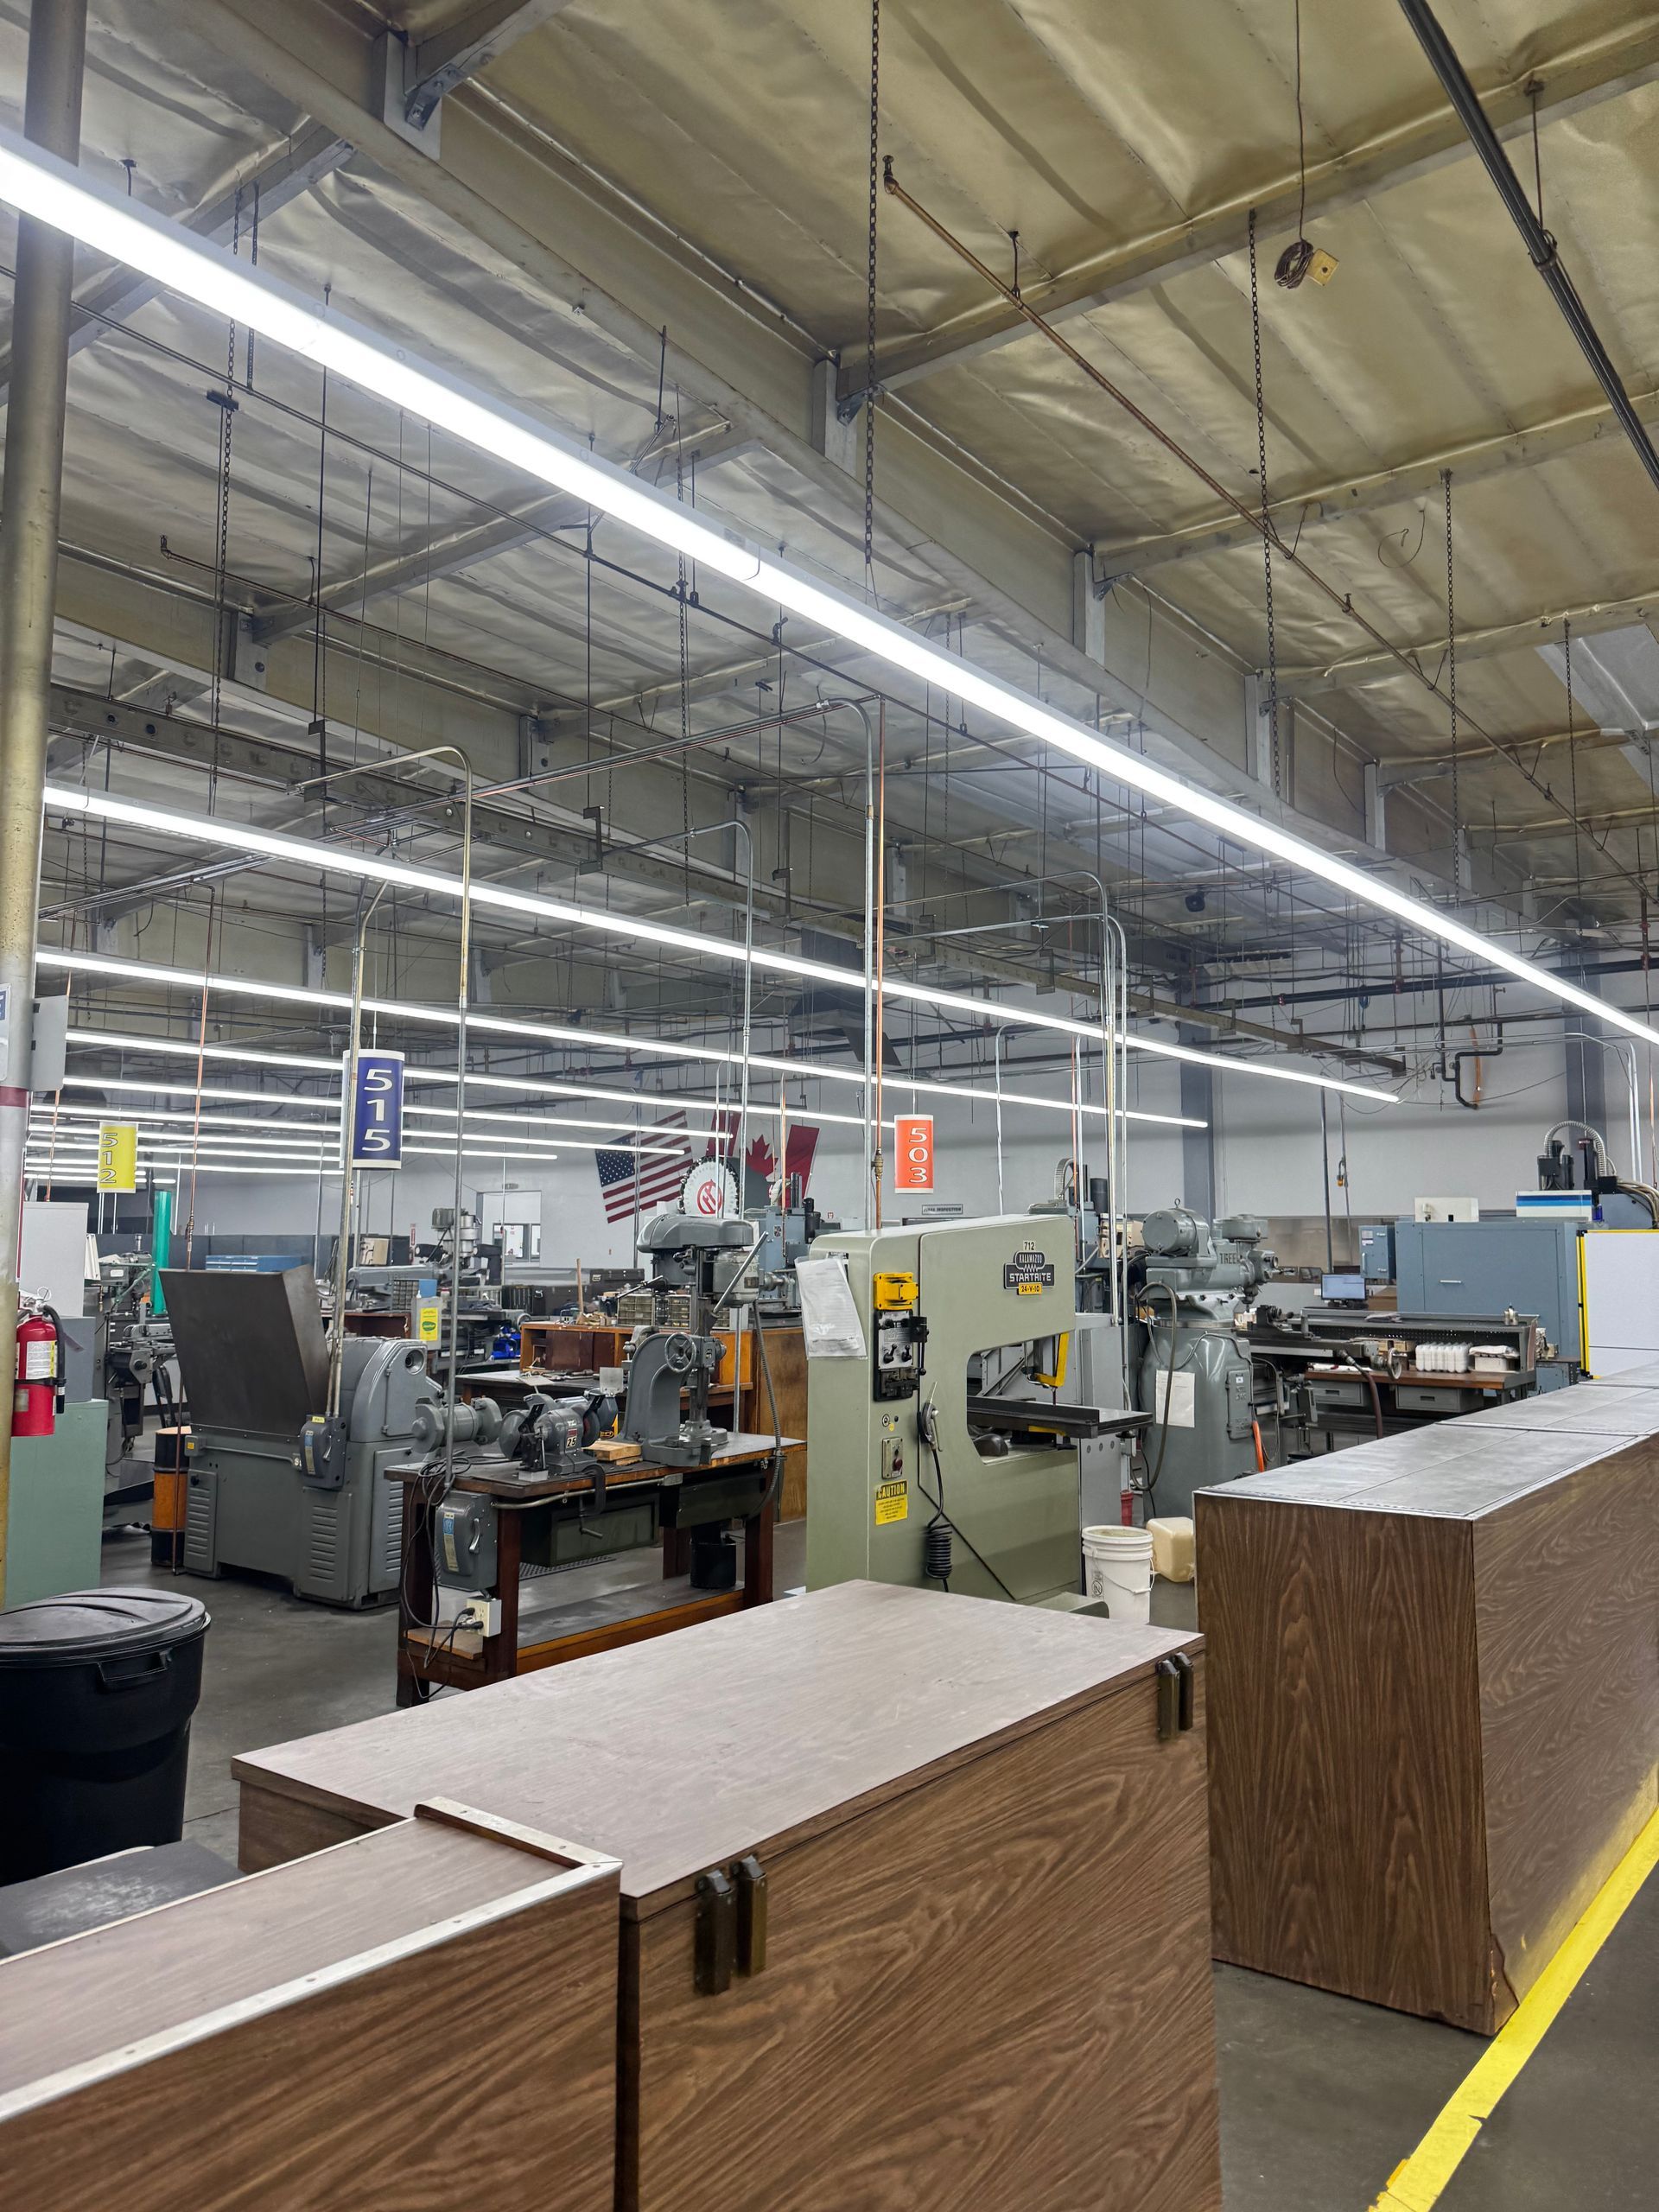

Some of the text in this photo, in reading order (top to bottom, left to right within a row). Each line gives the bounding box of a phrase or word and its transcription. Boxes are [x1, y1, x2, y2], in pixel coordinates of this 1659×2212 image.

[362, 1068, 393, 1152] 515
[100, 1133, 118, 1184] 512
[908, 1127, 929, 1184] 503
[1024, 1242, 1035, 1250] 712
[1019, 1254, 1043, 1264] KALAMAZOO
[1009, 1273, 1052, 1282] STARTRITE
[568, 1437, 576, 1447] 25
[877, 1482, 906, 1499] CAUTION
